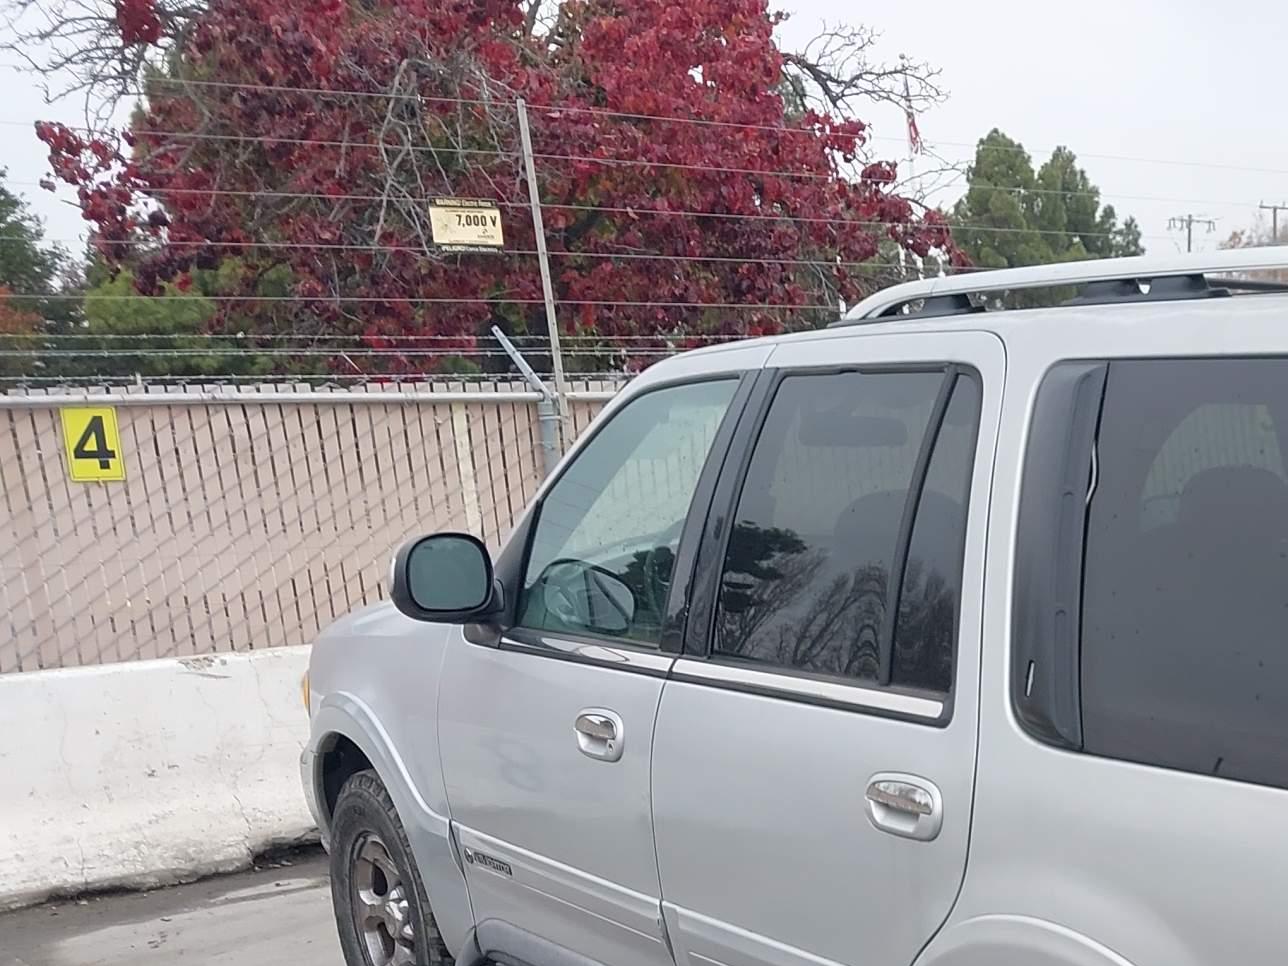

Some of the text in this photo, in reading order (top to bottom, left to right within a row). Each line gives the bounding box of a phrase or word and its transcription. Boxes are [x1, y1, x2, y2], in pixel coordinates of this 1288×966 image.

[456, 214, 497, 228] 7,000 V
[73, 415, 117, 470] 4
